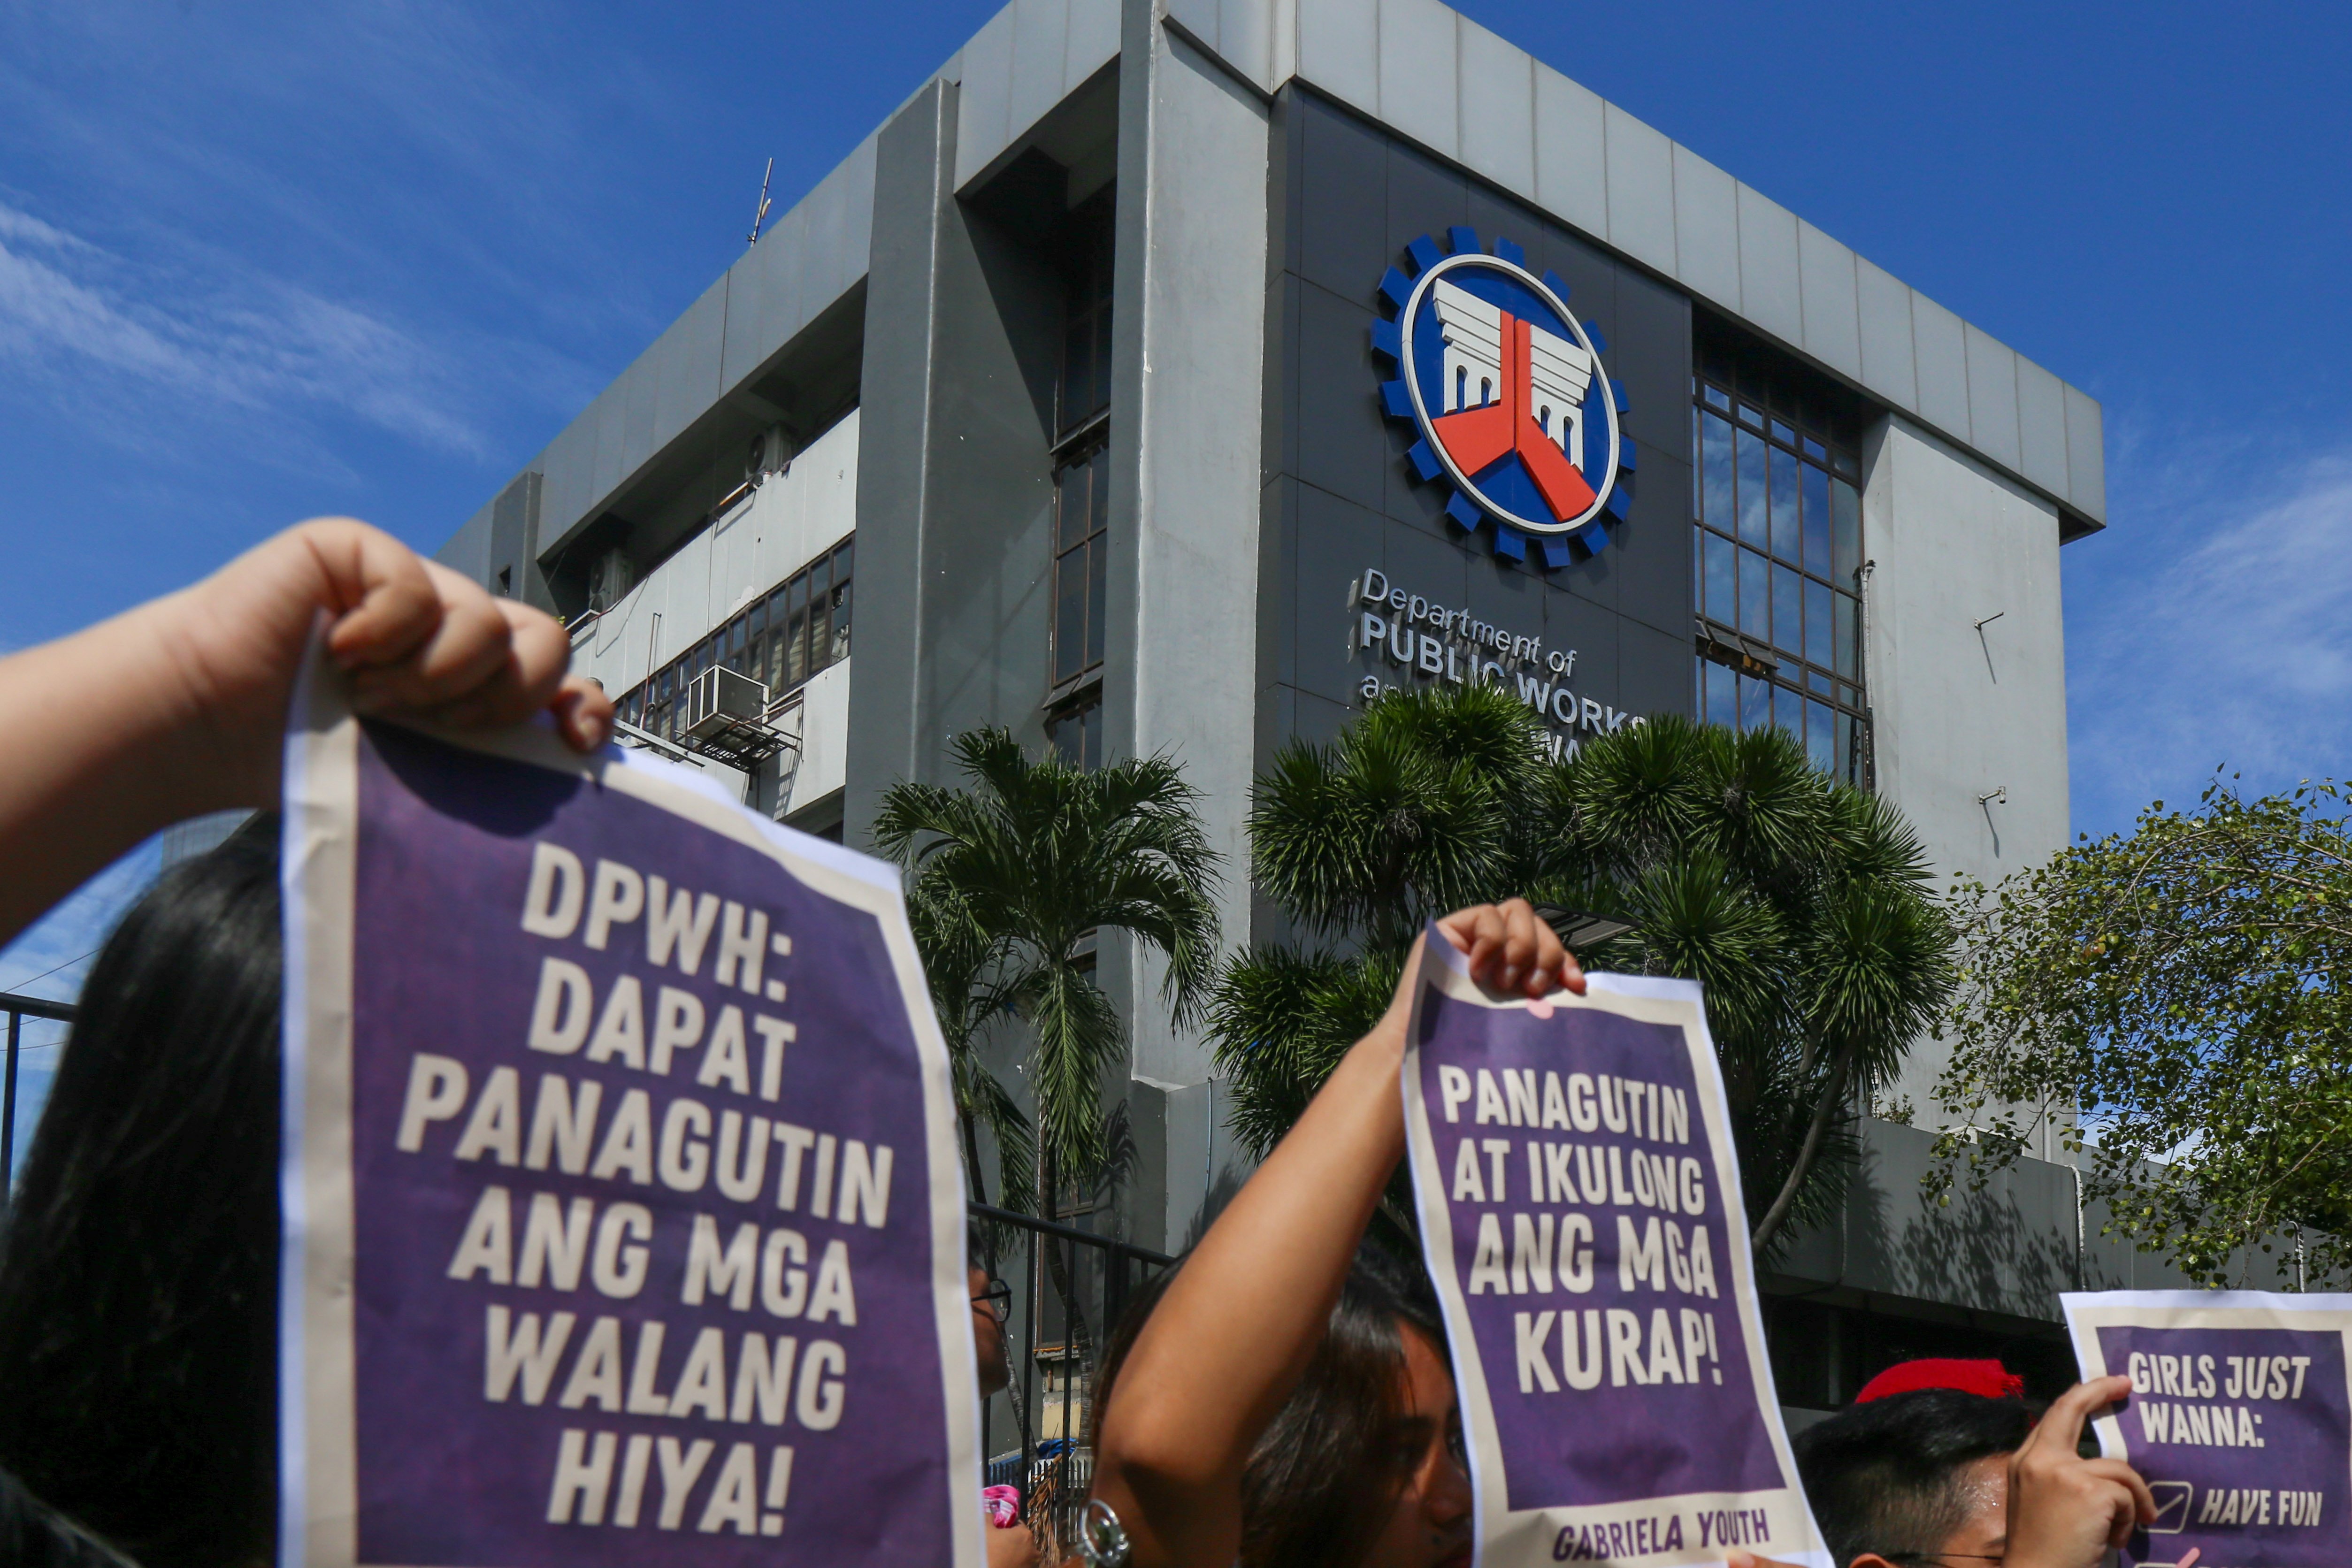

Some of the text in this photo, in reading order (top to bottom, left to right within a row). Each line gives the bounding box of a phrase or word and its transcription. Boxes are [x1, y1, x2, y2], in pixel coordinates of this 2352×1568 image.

[1362, 568, 1577, 677] Department of
[522, 842, 791, 1001] DPWH:
[529, 957, 796, 1101] DAPAT
[398, 1055, 892, 1227] PANAGUTIN
[1440, 1065, 1688, 1144] PANAGUTIN
[1453, 1139, 1704, 1215] AT IKULONG
[449, 1187, 856, 1325] ANG MGA
[1469, 1213, 1718, 1298] ANG MGA
[486, 1306, 845, 1430] WALANG
[1515, 1308, 1722, 1392] KURAP!
[2128, 1352, 2310, 1400] GIRLS JUST
[2138, 1401, 2264, 1447] WANNA:
[548, 1430, 793, 1535] HIYA!
[2199, 1489, 2322, 1526] HAVE FUN
[1553, 1509, 1770, 1562] GABRIELA YOUTH
